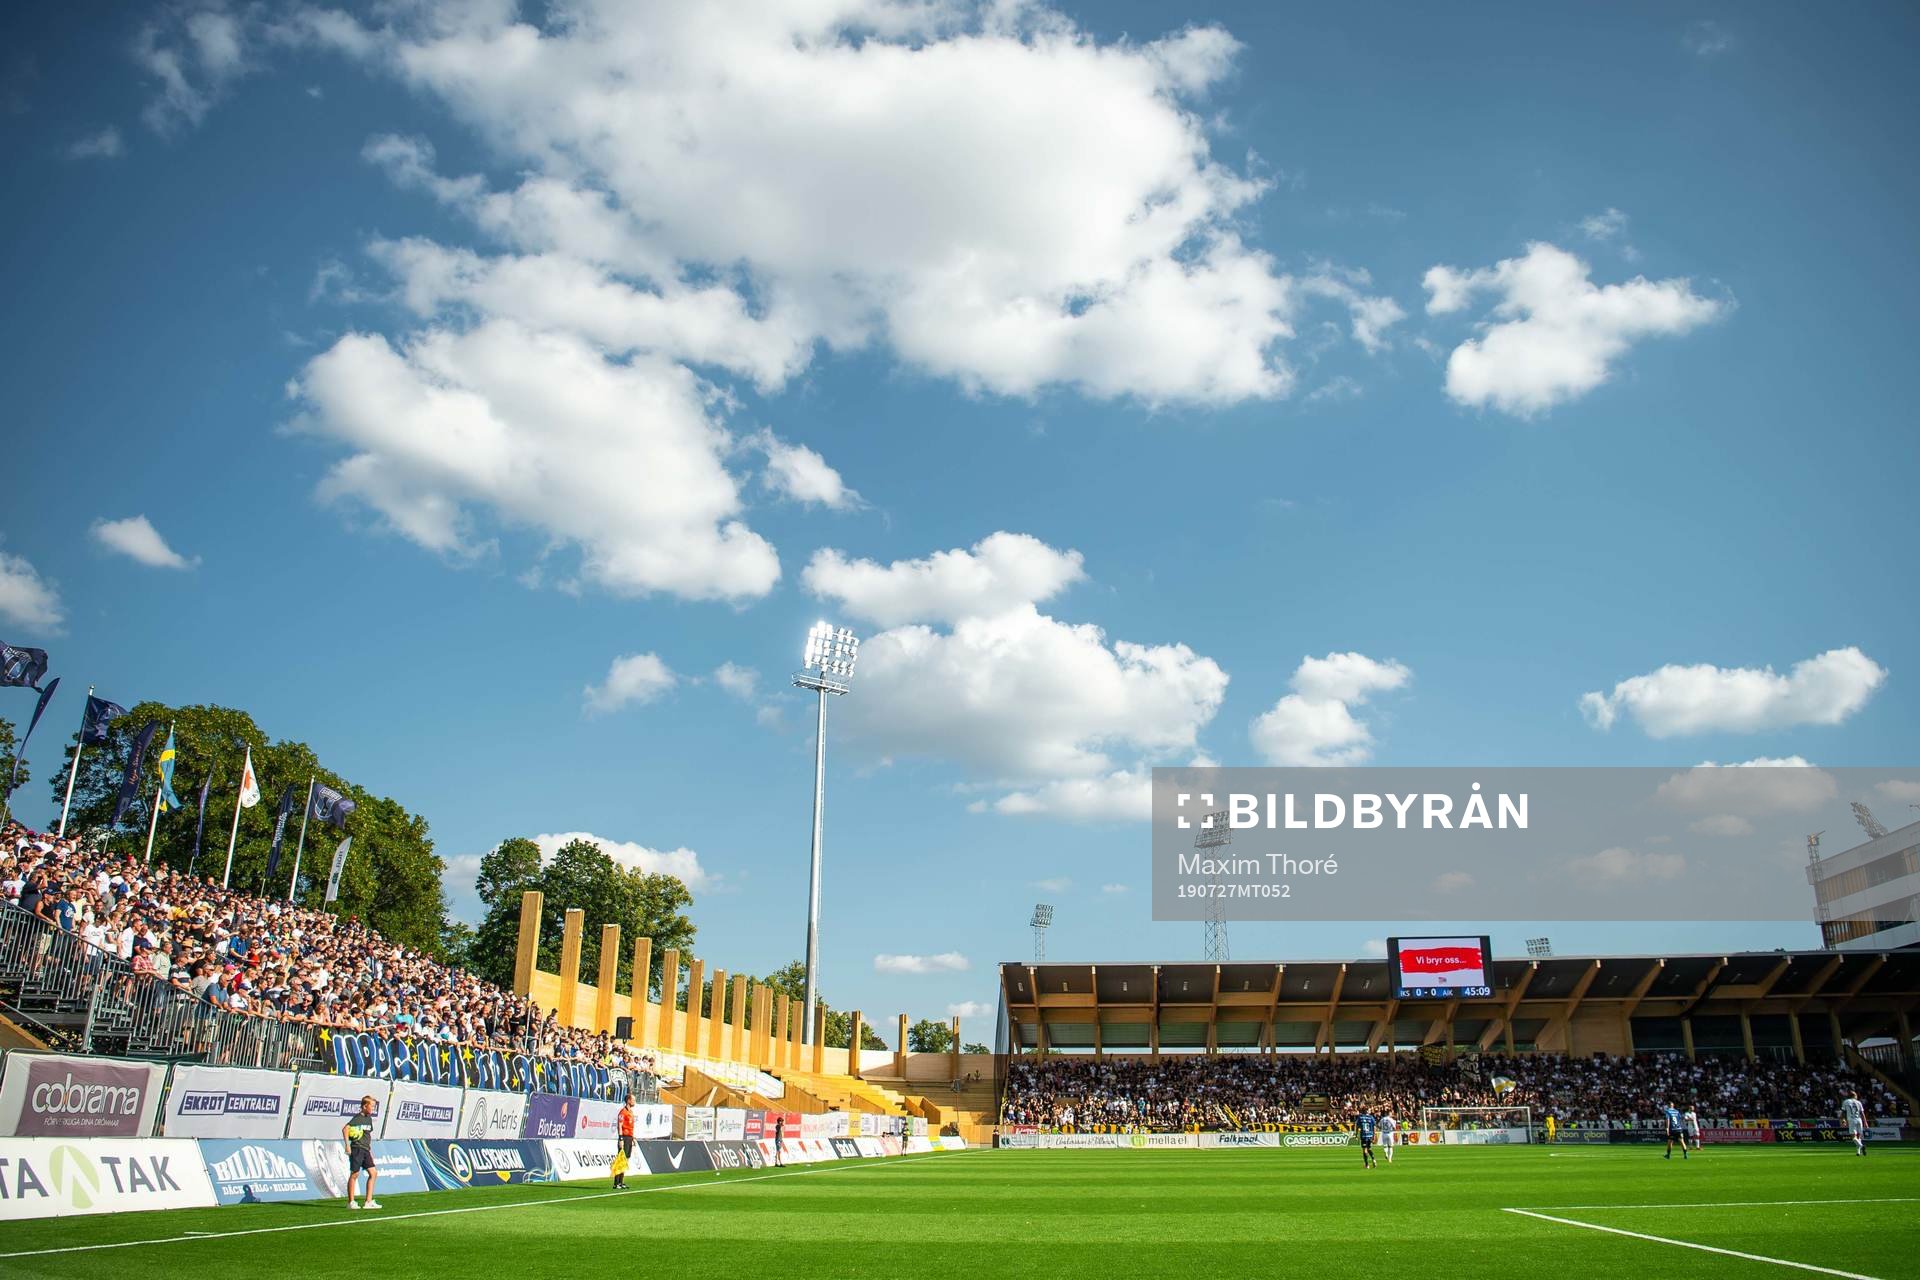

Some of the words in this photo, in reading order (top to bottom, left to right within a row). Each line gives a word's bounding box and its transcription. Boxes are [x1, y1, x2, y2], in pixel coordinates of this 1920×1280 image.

[1416, 956, 1425, 965] Vi
[1426, 956, 1443, 966] bryr
[1415, 988, 1422, 997] 0
[1430, 988, 1437, 997] 0
[1464, 987, 1491, 996] 45:09
[31, 1072, 140, 1115] colorama
[184, 1095, 225, 1111] SKROT
[227, 1096, 278, 1112] CENTRALEN
[307, 1099, 340, 1113] UPPSALA
[423, 1107, 453, 1120] CENTRALEN
[489, 1107, 518, 1130] Aleris
[537, 1118, 567, 1140] Biotage
[1219, 1134, 1258, 1144] Folkpool
[1286, 1135, 1348, 1145] CASHBUDDY
[210, 1145, 306, 1181] BILDEMO
[100, 1155, 182, 1194] TAK
